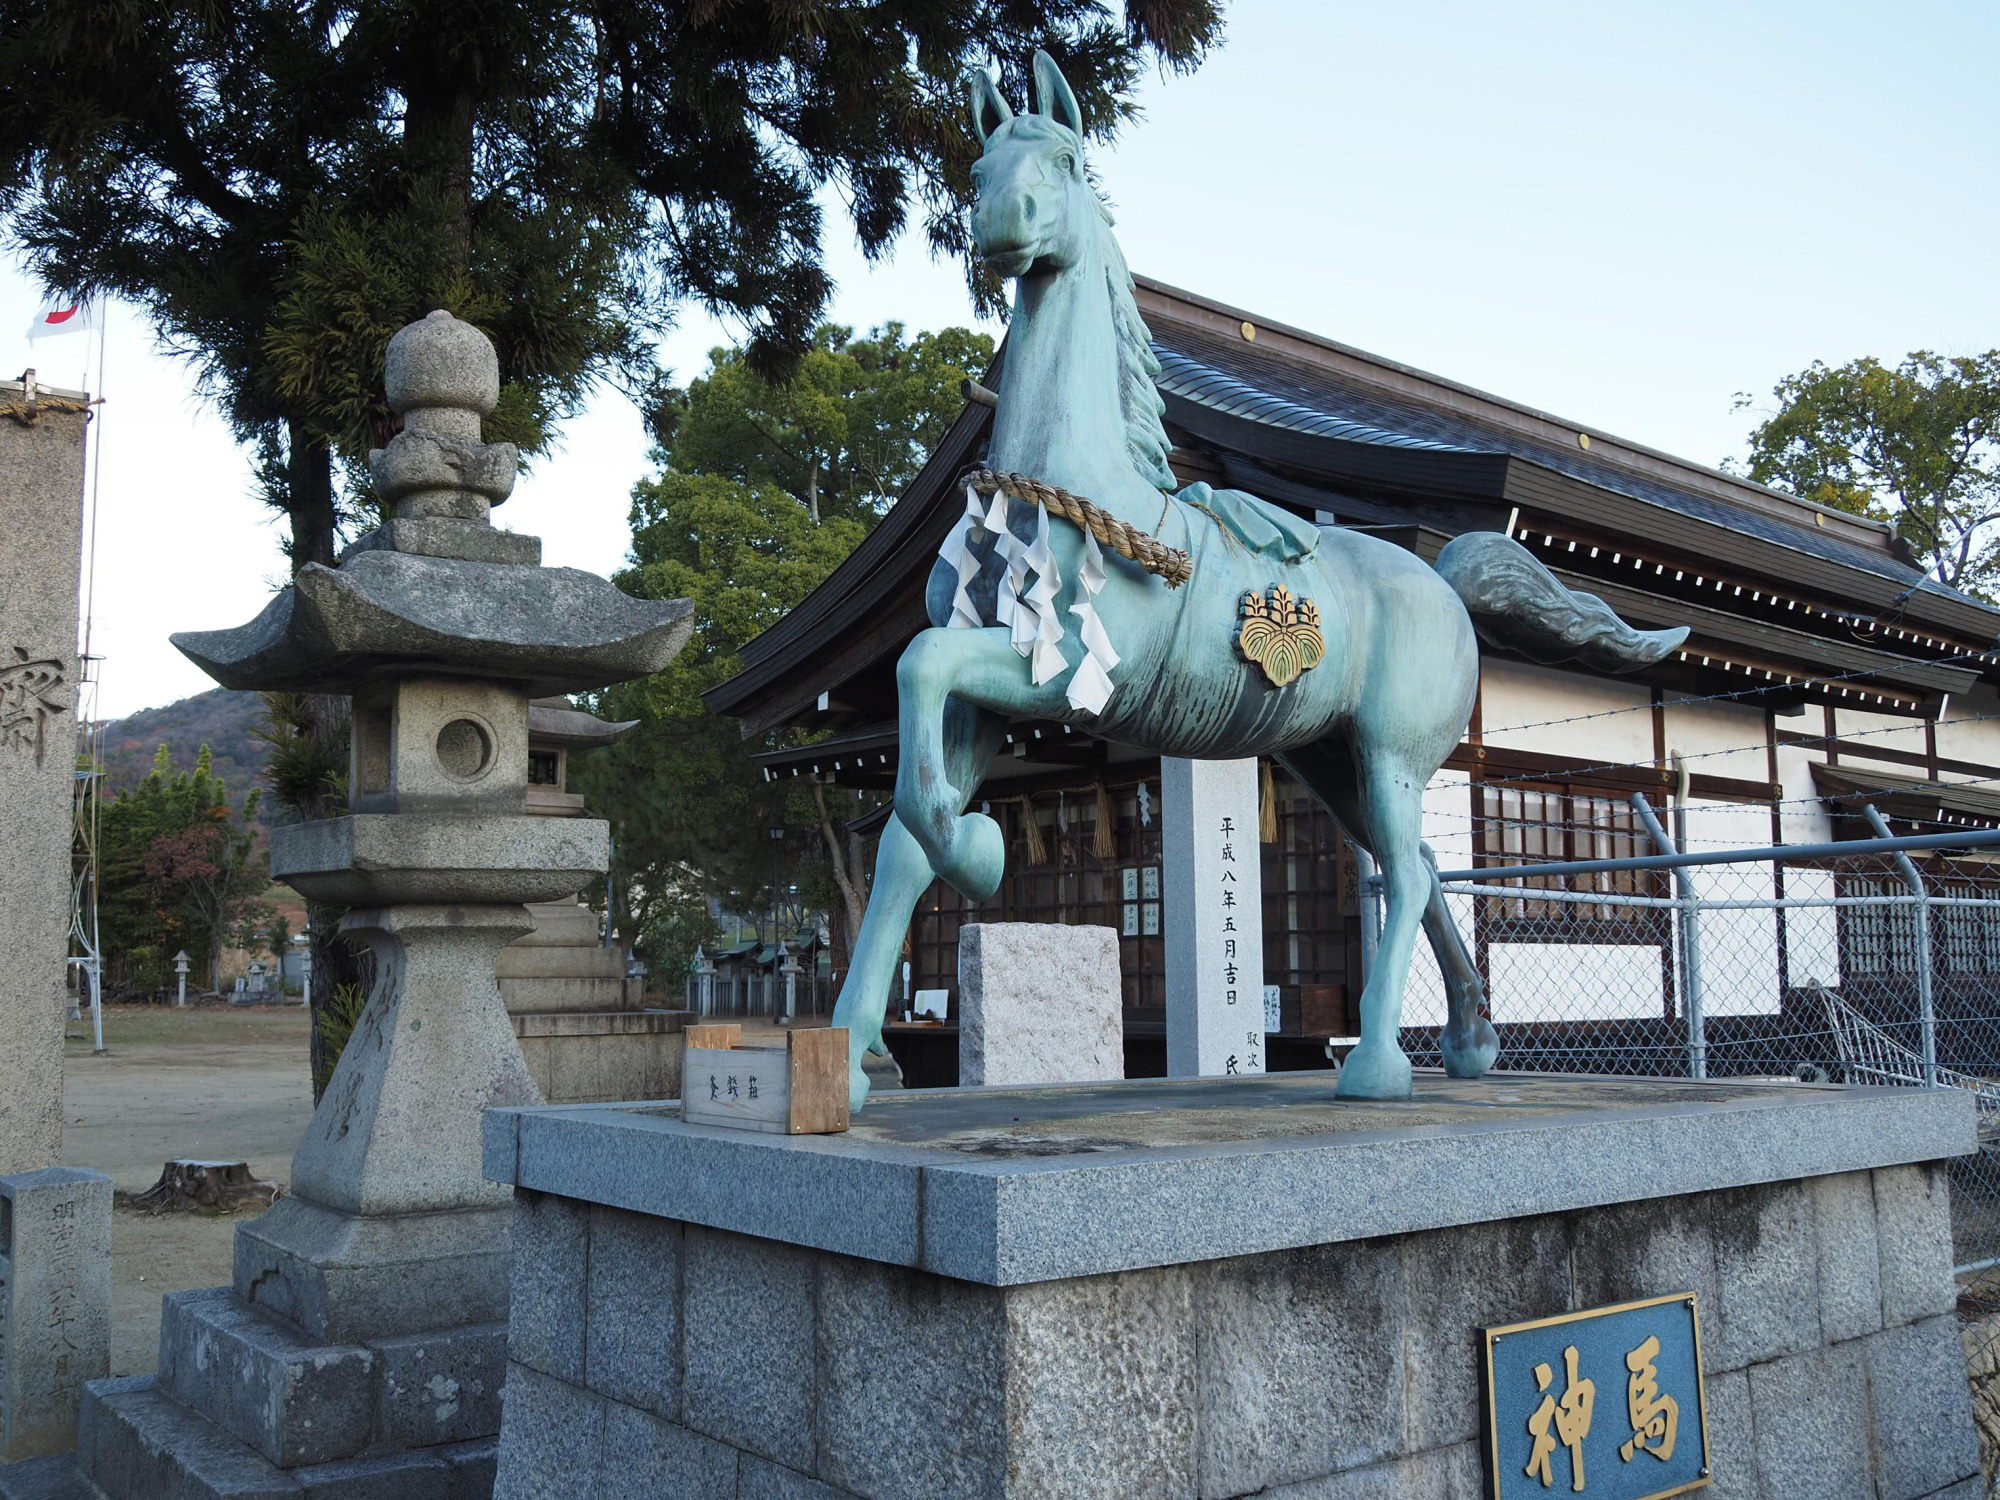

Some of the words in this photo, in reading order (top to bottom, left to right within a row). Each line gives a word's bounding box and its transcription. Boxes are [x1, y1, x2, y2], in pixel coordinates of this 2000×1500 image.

[1219, 816, 1239, 1006] 平成八年五月吉日
[1246, 1031, 1260, 1067] 取次
[1523, 1334, 1680, 1493] 神馬
